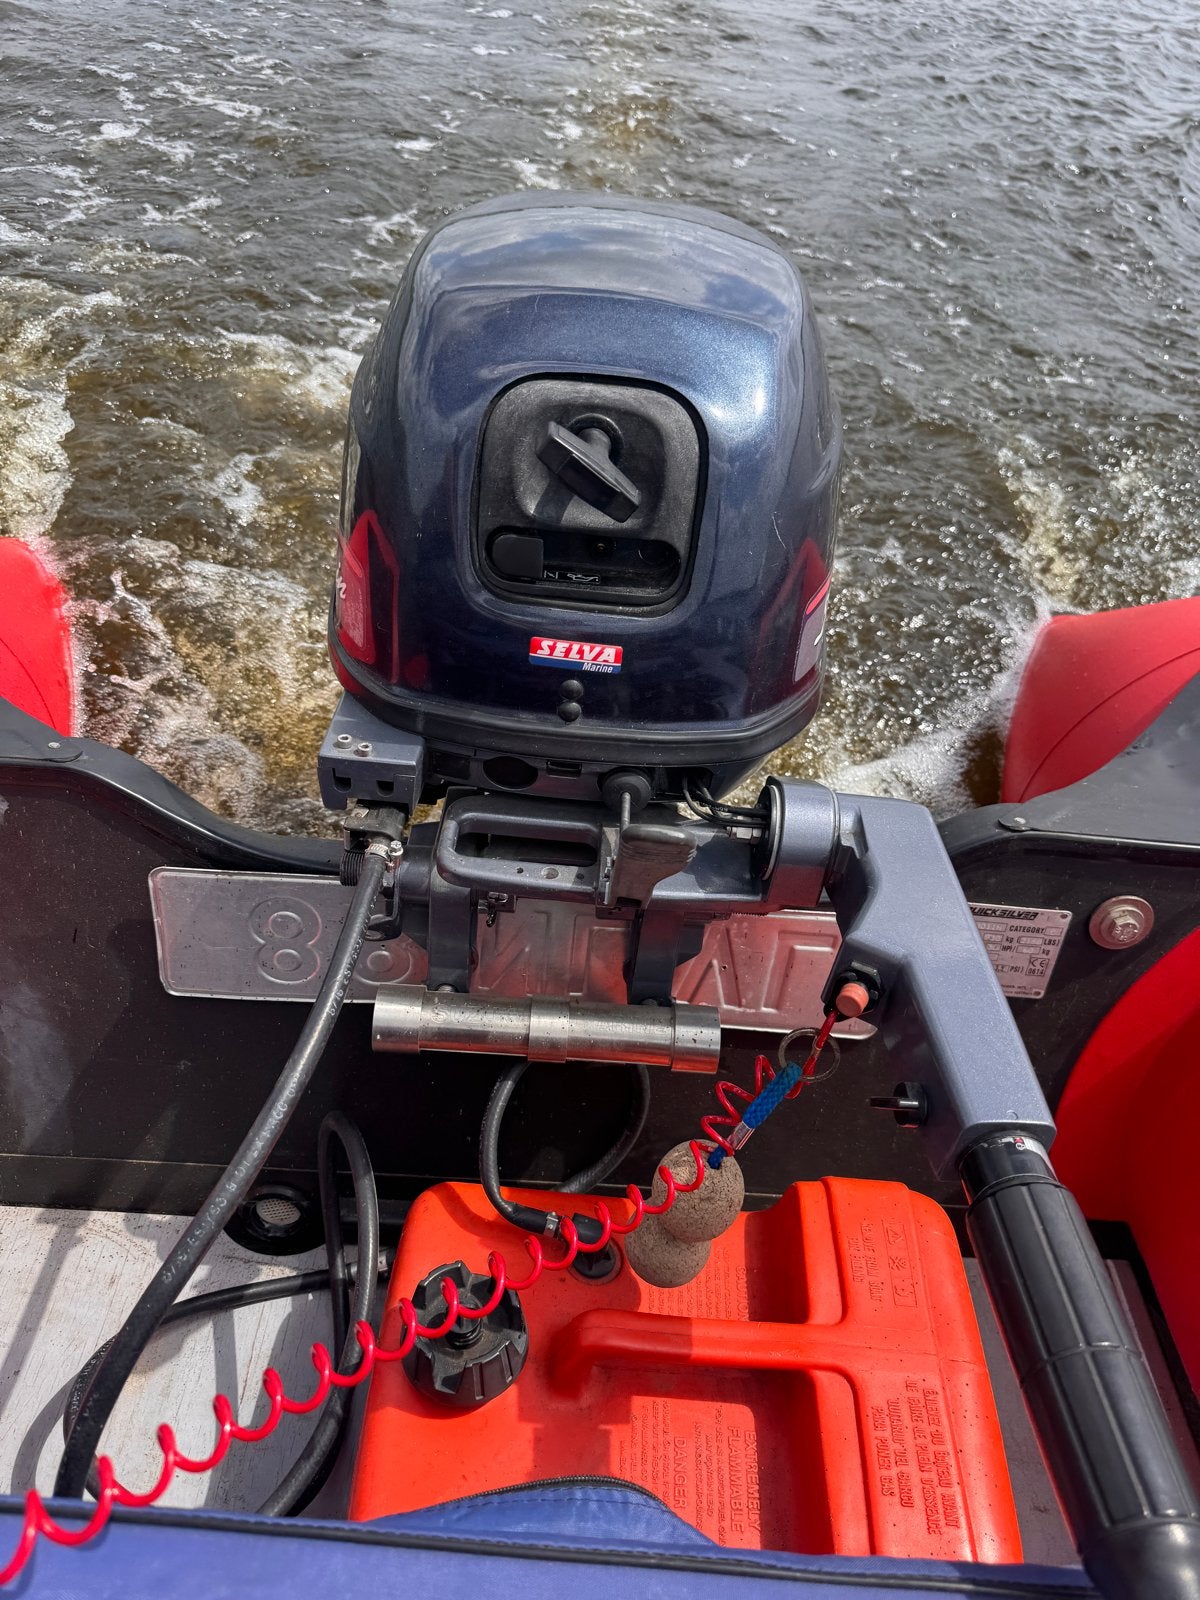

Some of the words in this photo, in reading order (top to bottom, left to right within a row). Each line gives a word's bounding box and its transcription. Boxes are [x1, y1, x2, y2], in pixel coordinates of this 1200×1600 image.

[536, 640, 616, 663] SELVA
[582, 662, 613, 673] Marine
[1009, 925, 1045, 934] CATEGORY
[674, 1436, 687, 1509] DANGER
[728, 1426, 744, 1533] FLAMMABLE
[745, 1431, 760, 1532] EXTREMELY
